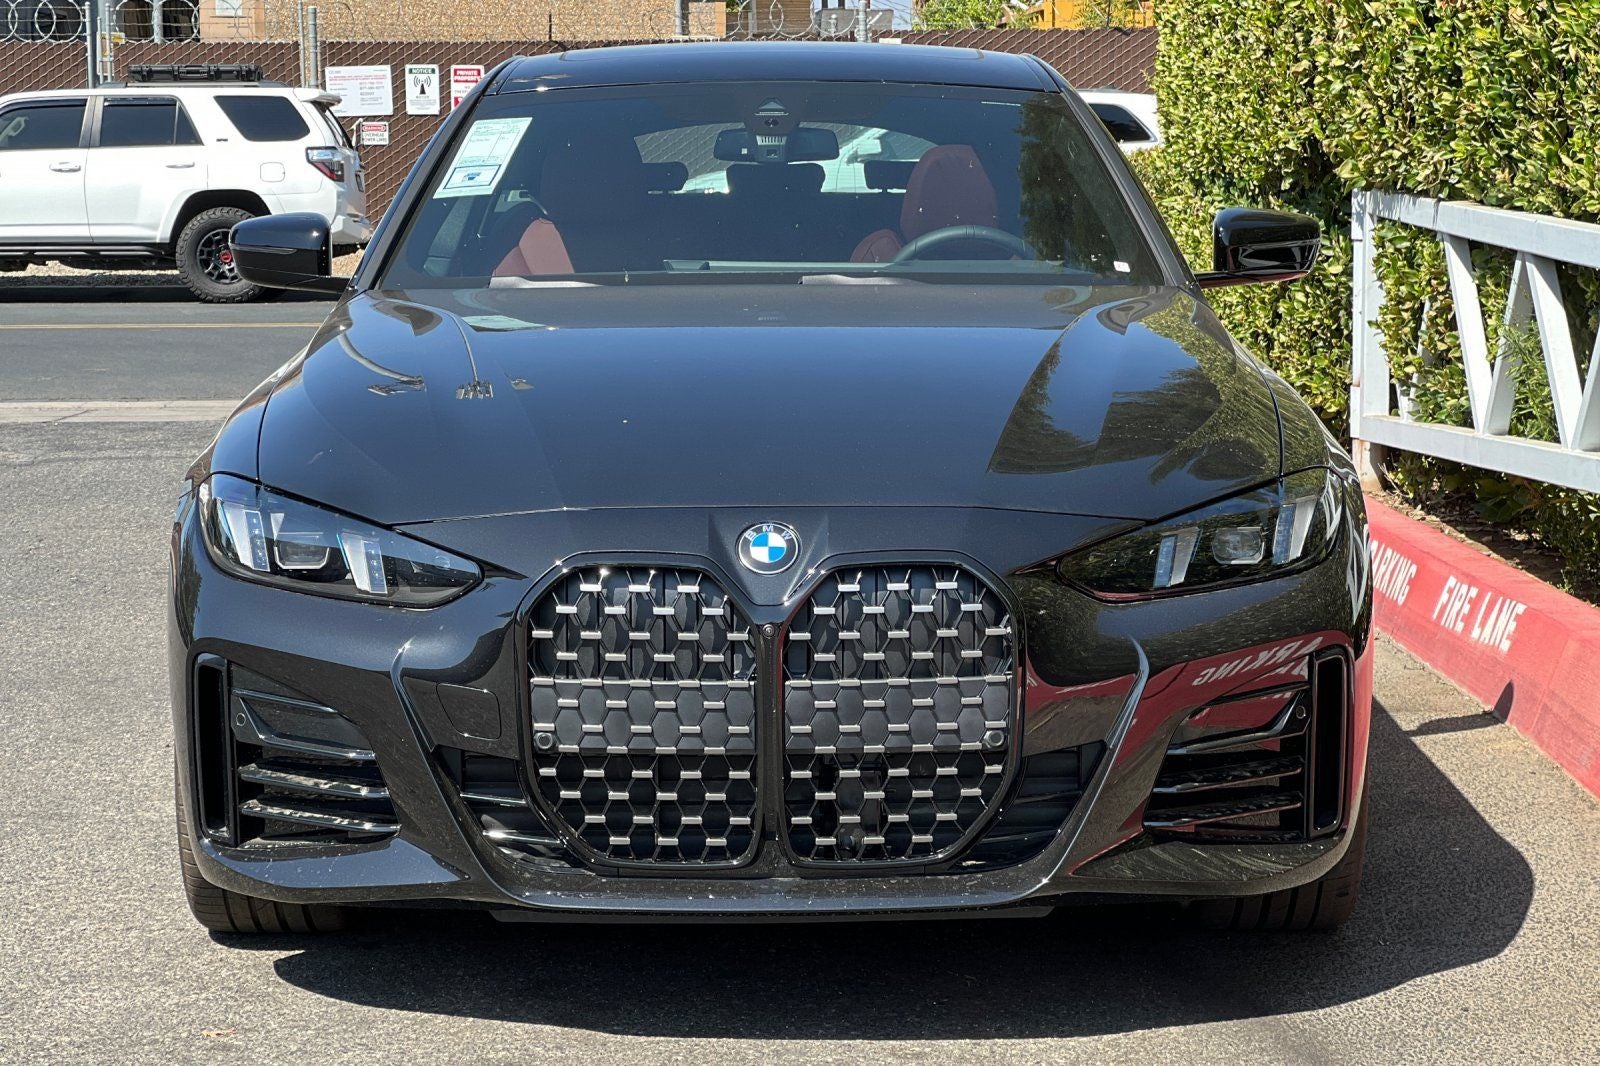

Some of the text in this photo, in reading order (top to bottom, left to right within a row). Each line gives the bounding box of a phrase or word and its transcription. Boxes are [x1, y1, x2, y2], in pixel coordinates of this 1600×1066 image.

[745, 525, 792, 541] BMW
[1432, 574, 1479, 634] FIRE
[1470, 591, 1528, 654] LANE
